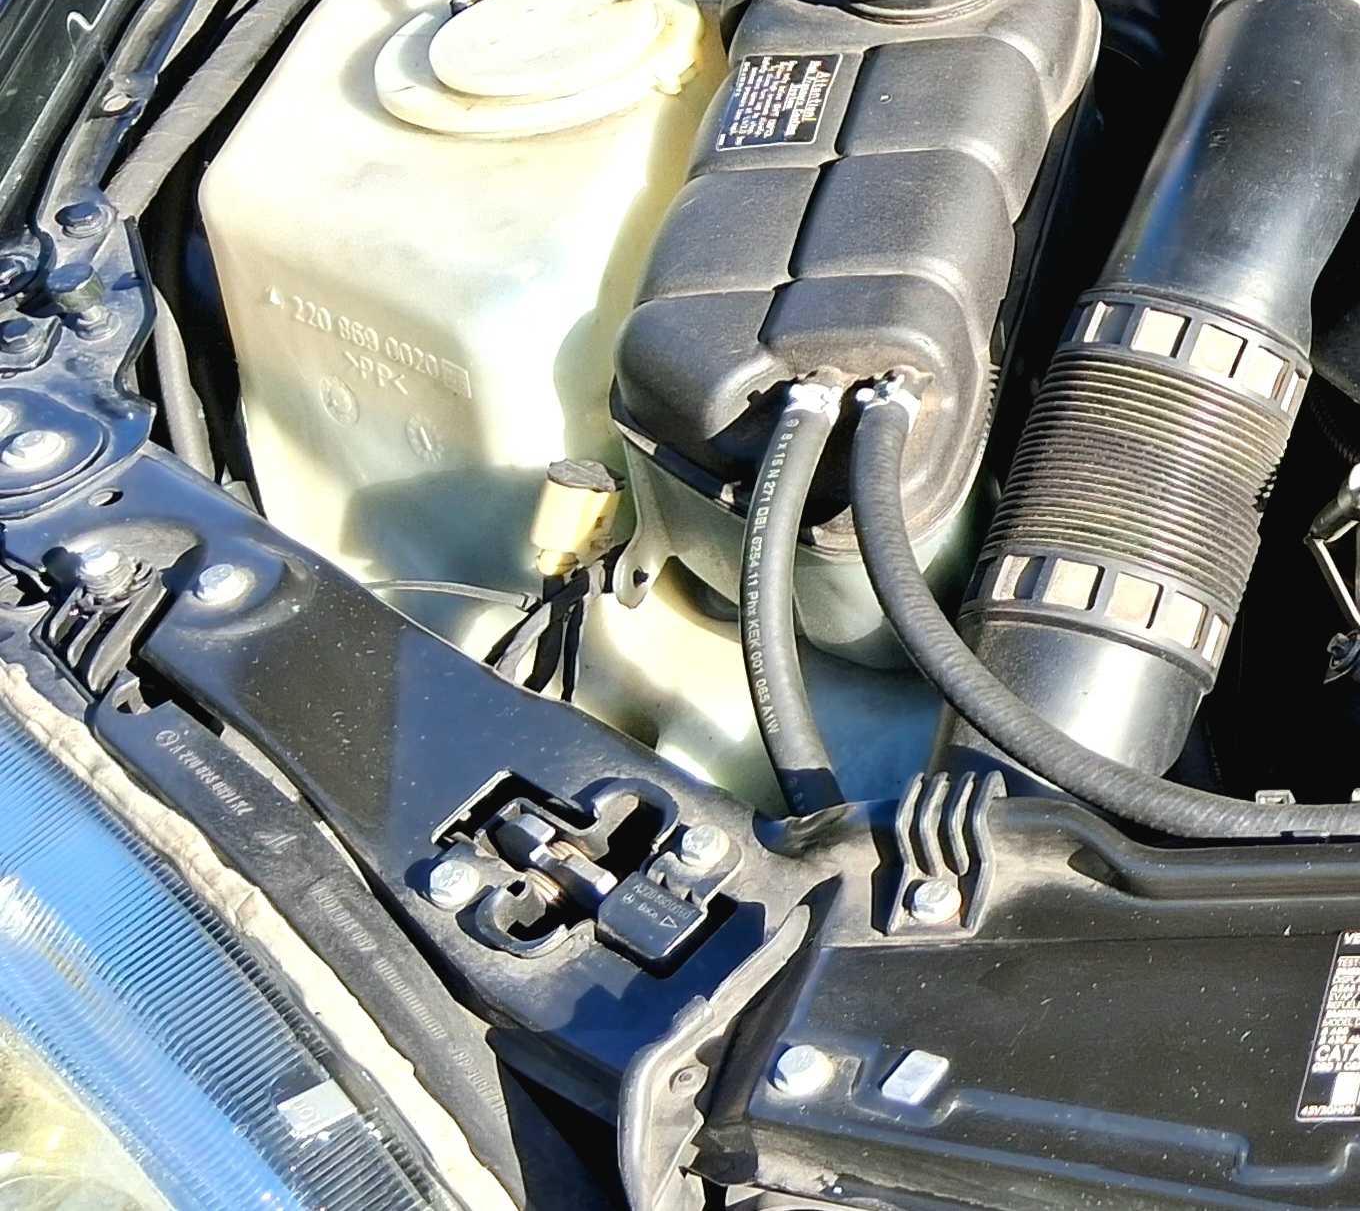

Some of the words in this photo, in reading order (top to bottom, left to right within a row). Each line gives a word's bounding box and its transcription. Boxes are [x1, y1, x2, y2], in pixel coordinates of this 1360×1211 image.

[291, 296, 332, 332] 220
[339, 316, 380, 352] 869
[385, 337, 439, 378] 0020
[771, 468, 784, 480] N
[764, 481, 780, 503] 271
[755, 506, 772, 531] DBL
[746, 591, 759, 617] Phx
[746, 618, 762, 650] KEK
[750, 652, 765, 677] 001
[1323, 1017, 1355, 1026] MODEL
